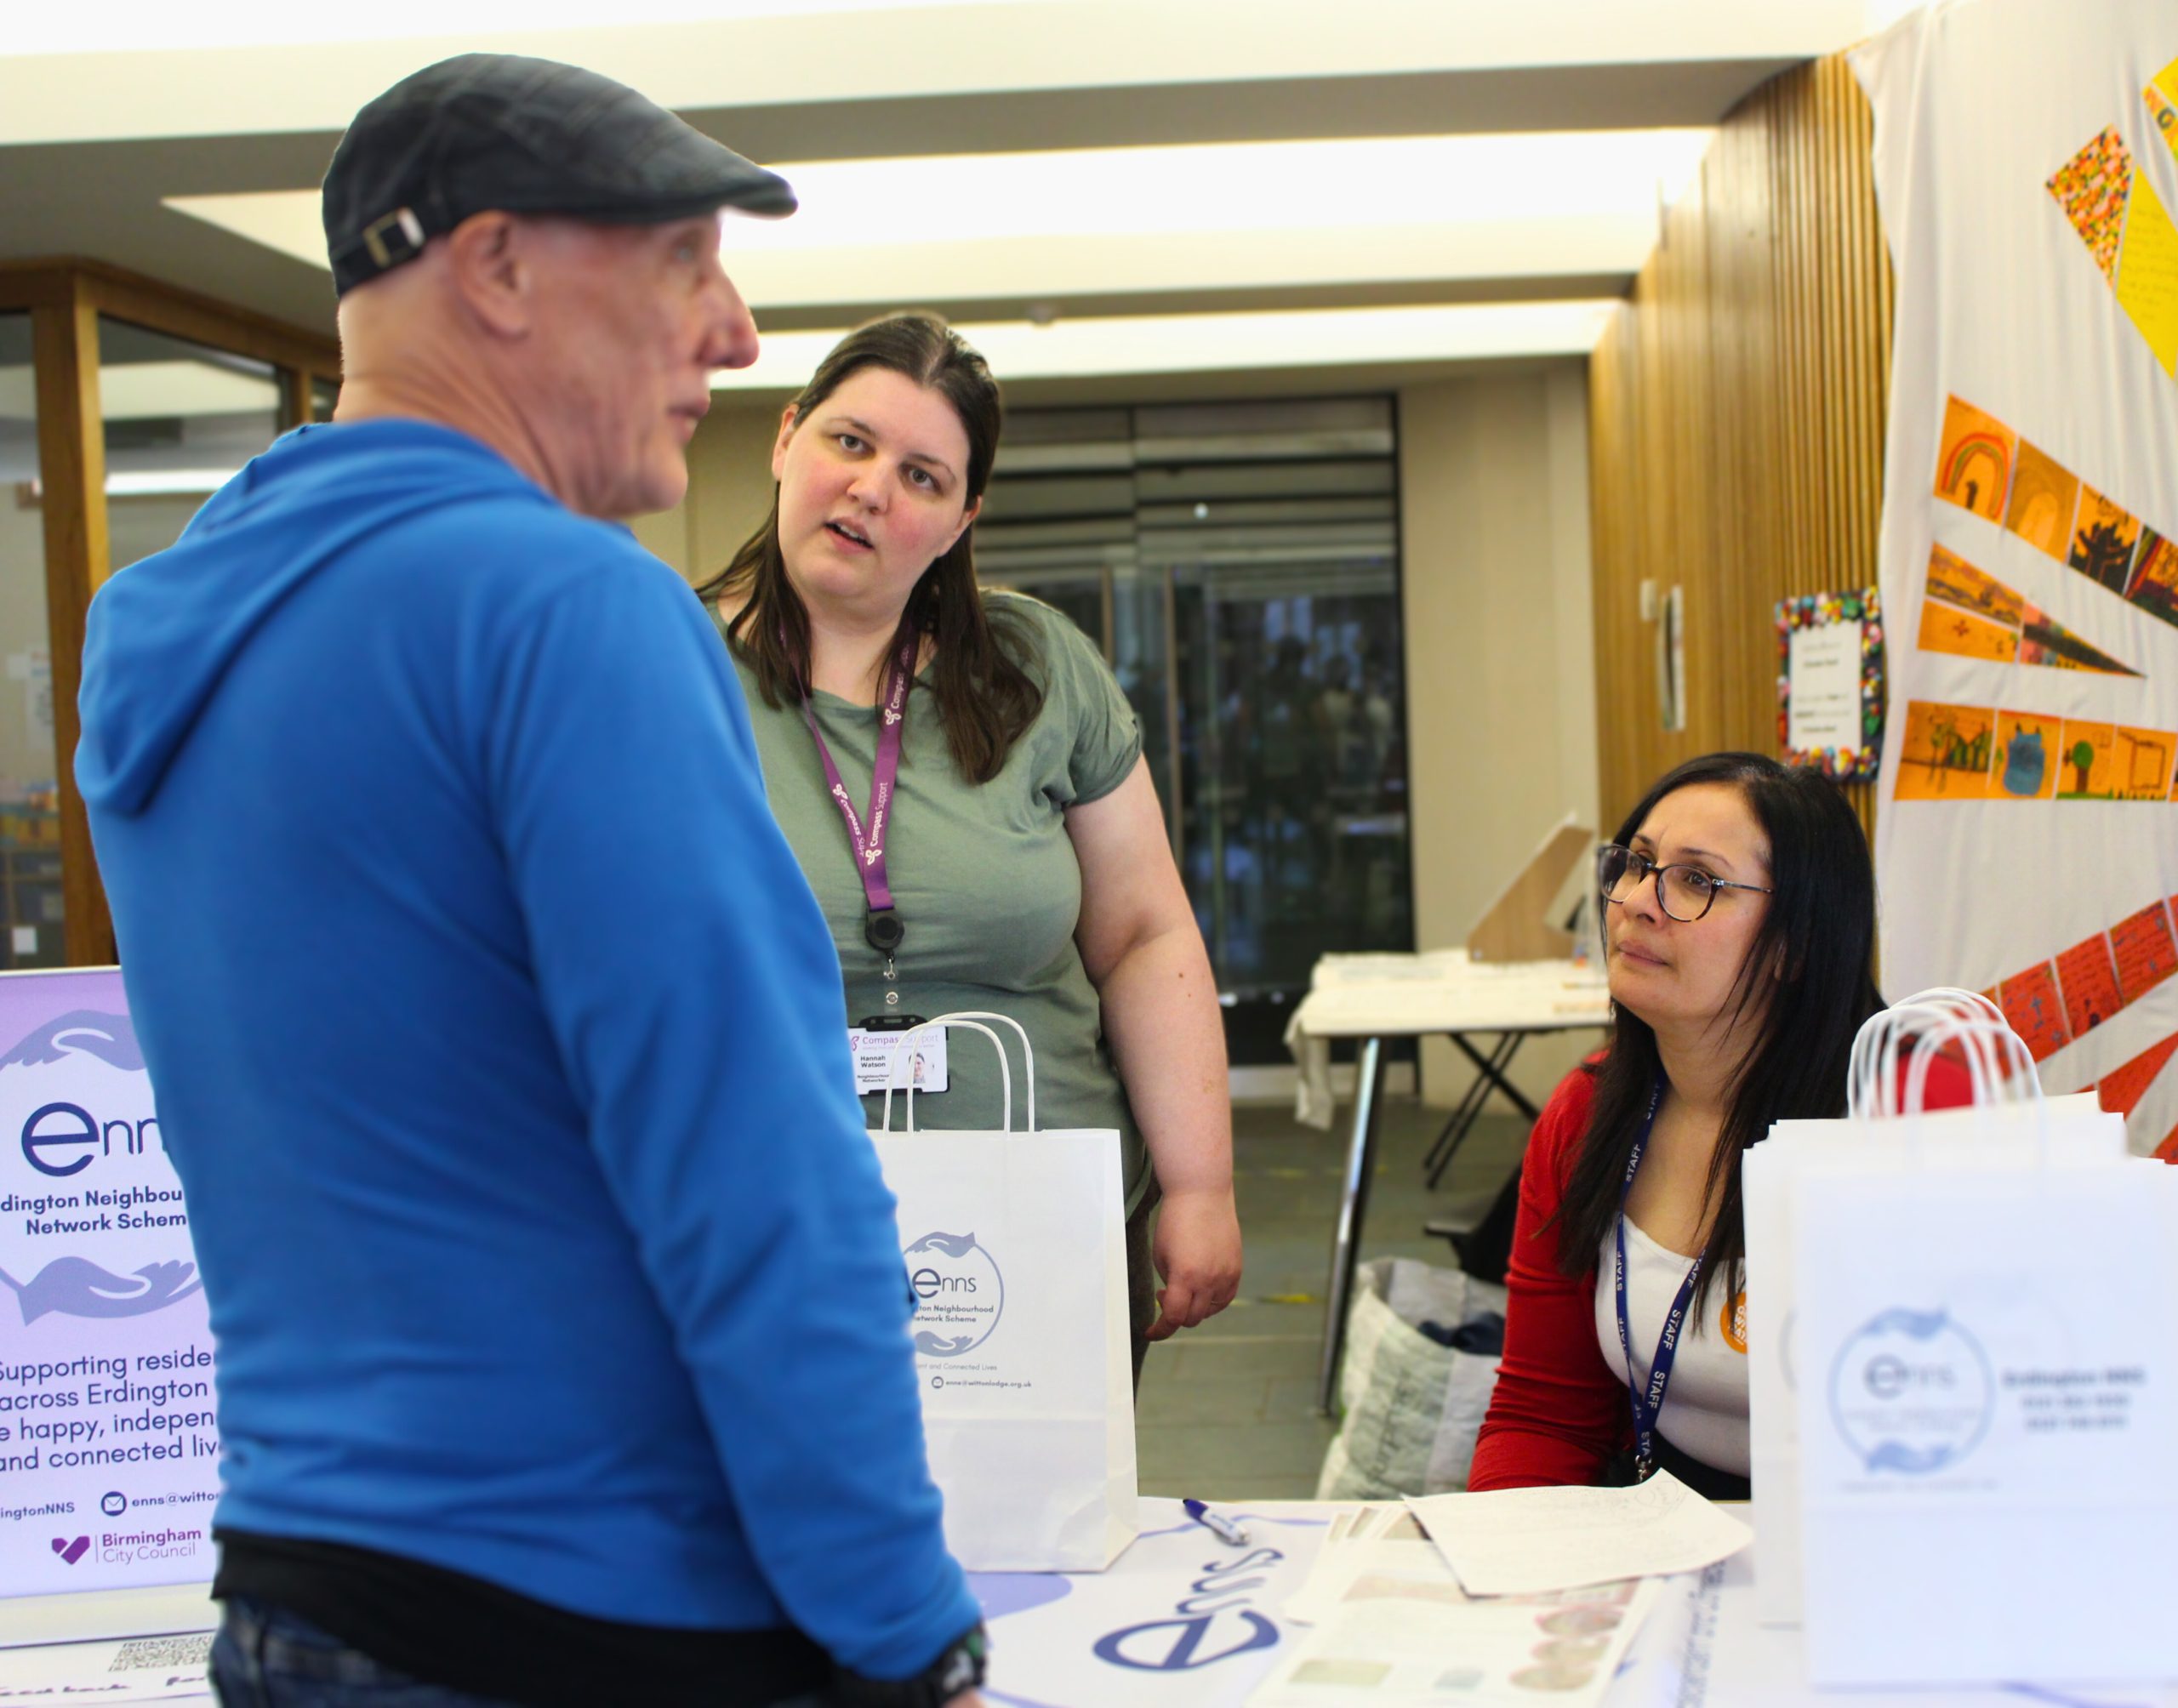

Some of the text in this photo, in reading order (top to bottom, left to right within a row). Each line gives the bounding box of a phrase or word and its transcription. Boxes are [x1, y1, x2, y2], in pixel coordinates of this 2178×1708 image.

[840, 799, 862, 835] Compass
[870, 783, 888, 847] Compass Support
[862, 1035, 899, 1045] Compas
[21, 1102, 166, 1177] enn
[1626, 1143, 1641, 1182] STAFF
[0, 1185, 183, 1215] dington Neighbou
[26, 1210, 187, 1235] Network Schem
[912, 1267, 978, 1299] enns
[933, 1305, 994, 1314] Neighbourhood
[1662, 1308, 1682, 1351] STAFF
[137, 1344, 212, 1371] reside
[0, 1379, 208, 1411] across Erdington
[1647, 1370, 1666, 1409] STAFF
[0, 1408, 214, 1444] e happy, indepen
[48, 1435, 183, 1467] connected
[193, 1434, 218, 1457] liv
[1640, 1431, 1651, 1457] STA
[0, 1502, 75, 1520] ingtonNNS
[102, 1528, 202, 1547] Birmingham
[103, 1541, 196, 1566] City Council
[1092, 1547, 1284, 1672] enns
